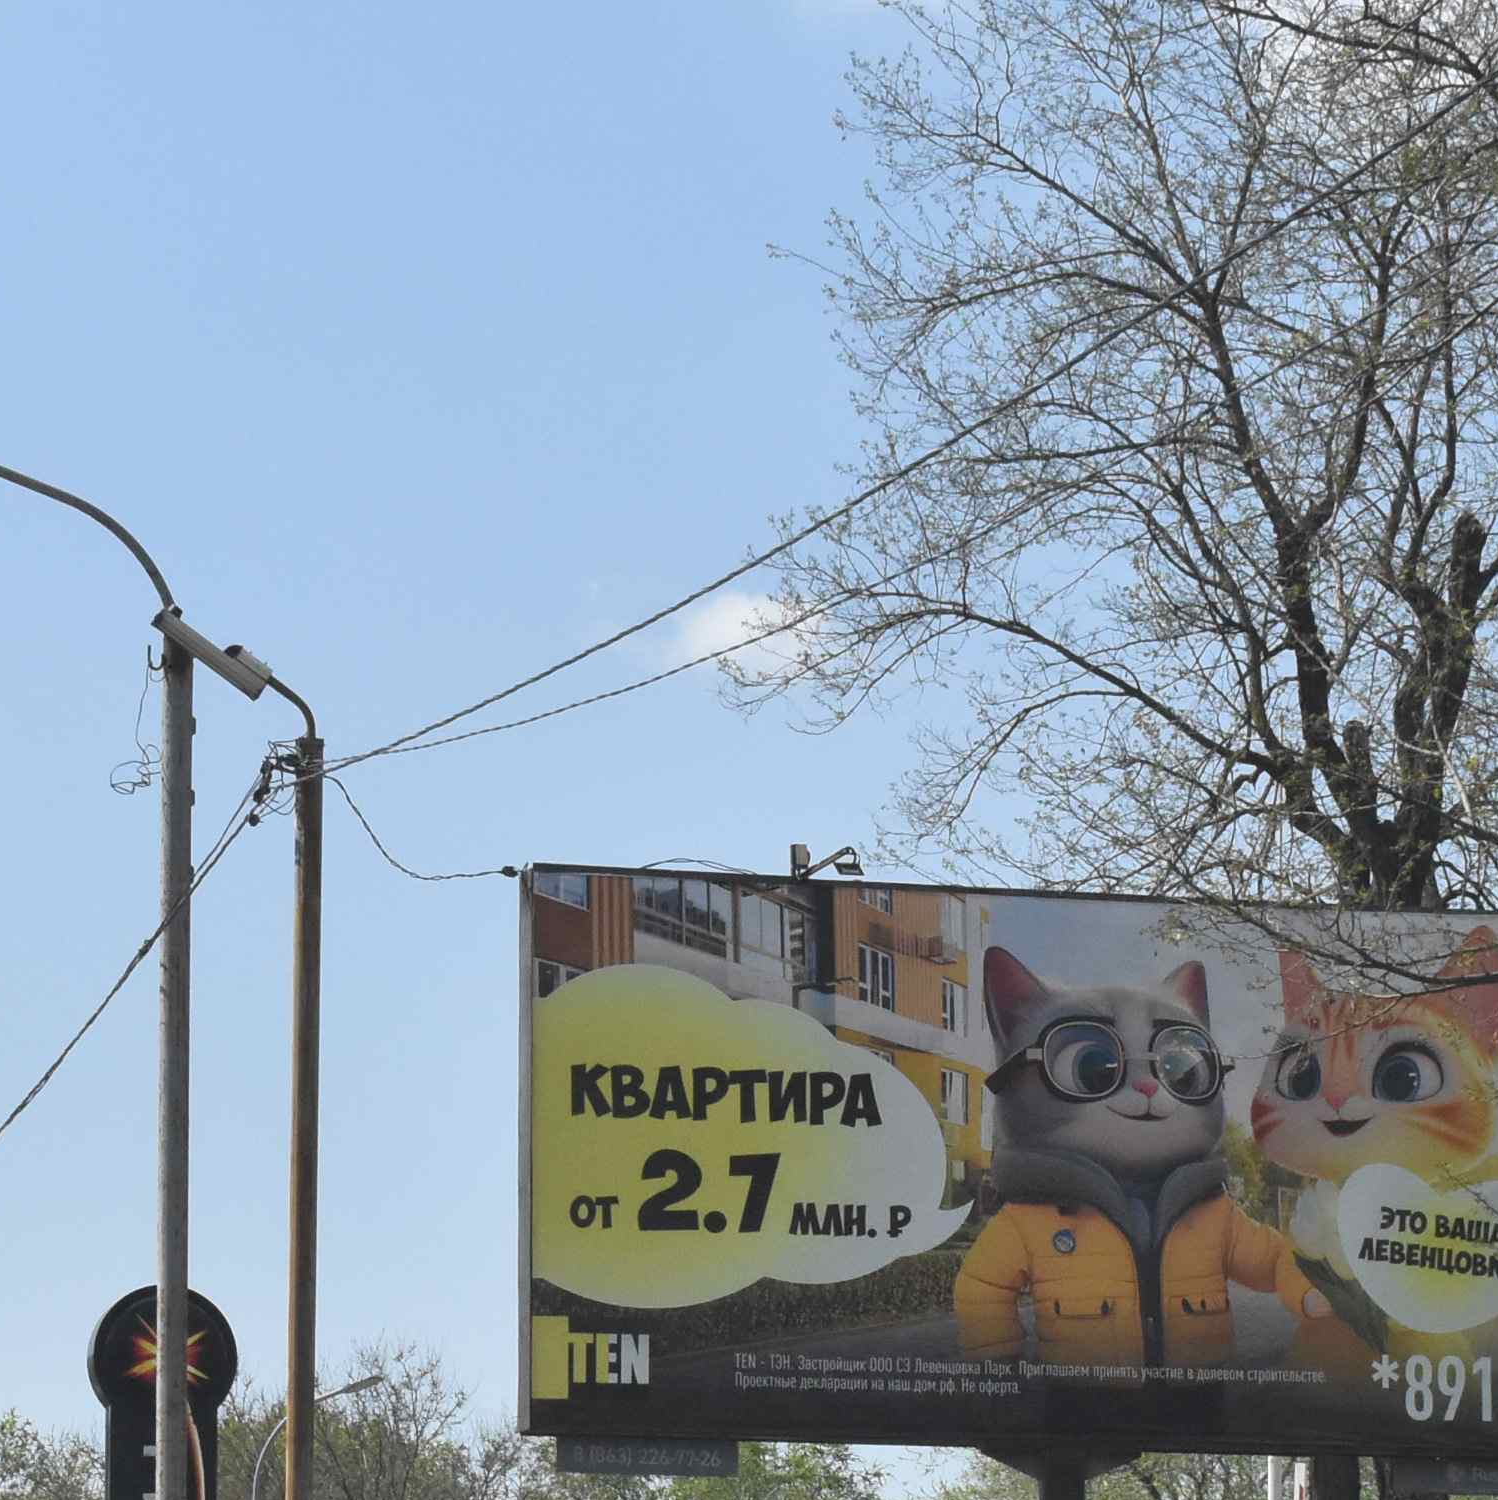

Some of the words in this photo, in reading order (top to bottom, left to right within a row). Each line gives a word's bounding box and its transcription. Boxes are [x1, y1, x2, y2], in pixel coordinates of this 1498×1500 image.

[570, 1063, 883, 1128] КВАРТИРА
[637, 1148, 781, 1234] 2.7
[1380, 1206, 1428, 1235] ЭТО
[565, 1332, 650, 1385] TEN
[1019, 1361, 1090, 1379] Приглашаем
[1093, 1366, 1138, 1381] принять
